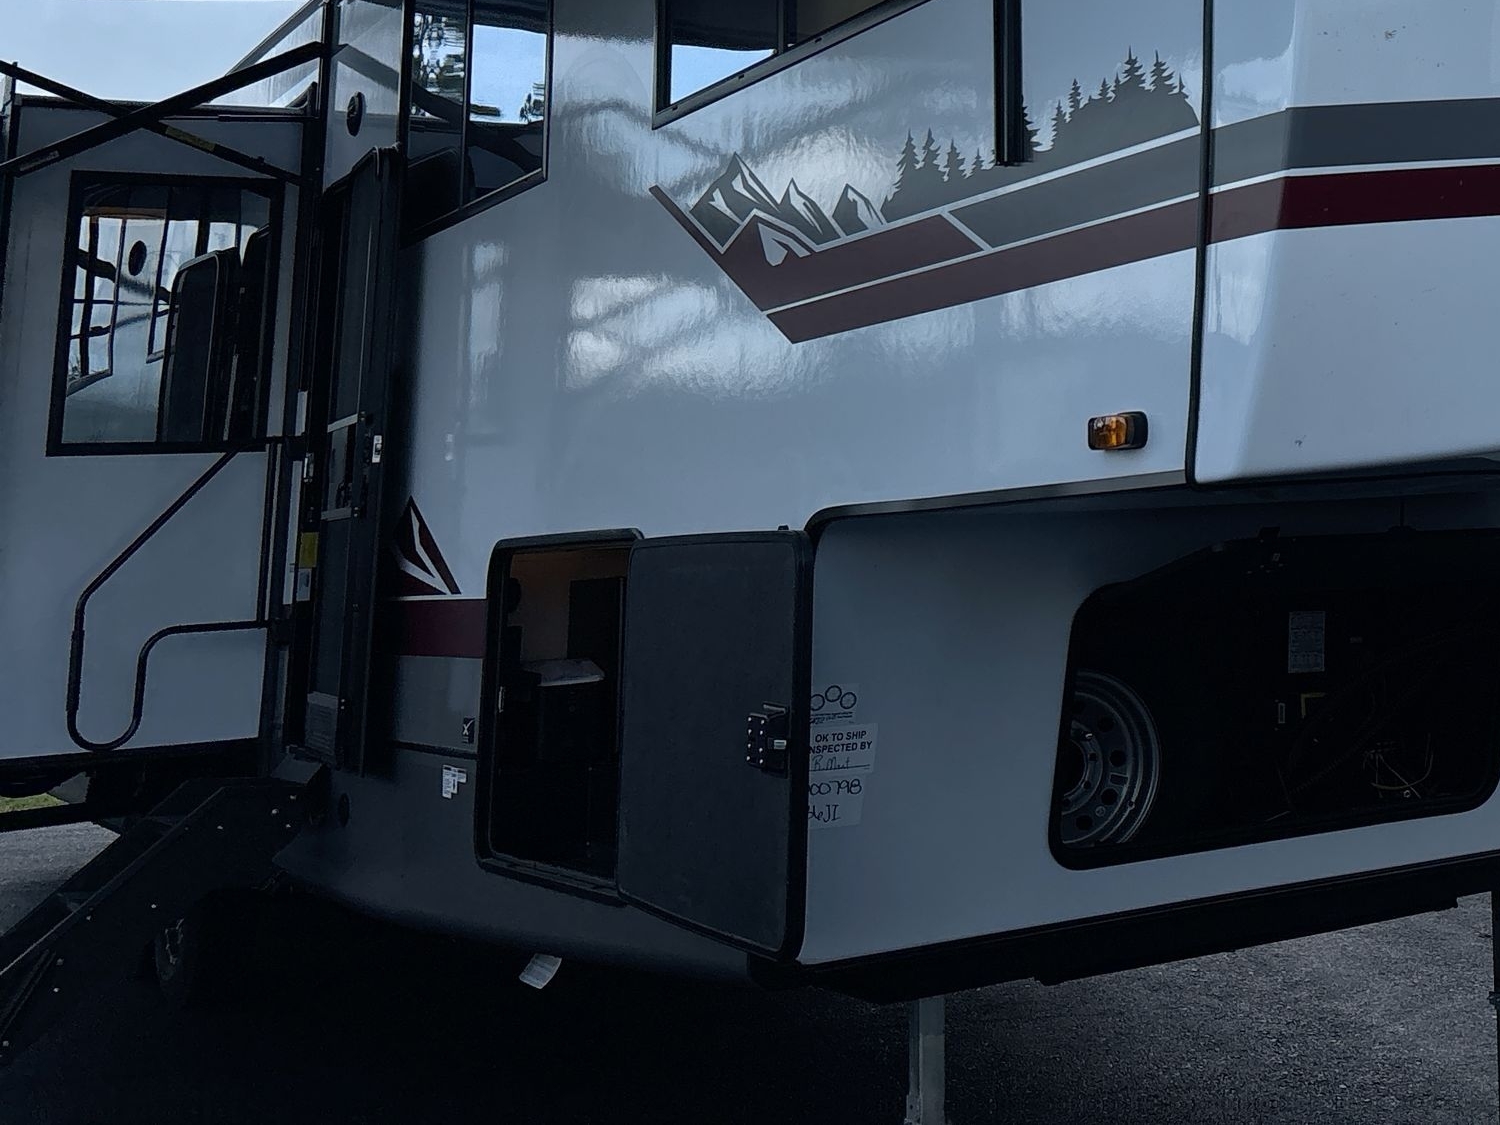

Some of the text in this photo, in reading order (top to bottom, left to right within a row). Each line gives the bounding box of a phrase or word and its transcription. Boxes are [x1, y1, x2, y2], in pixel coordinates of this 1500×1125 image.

[815, 730, 867, 743] OK TO SHIP
[808, 740, 872, 754] NSPECTED BY
